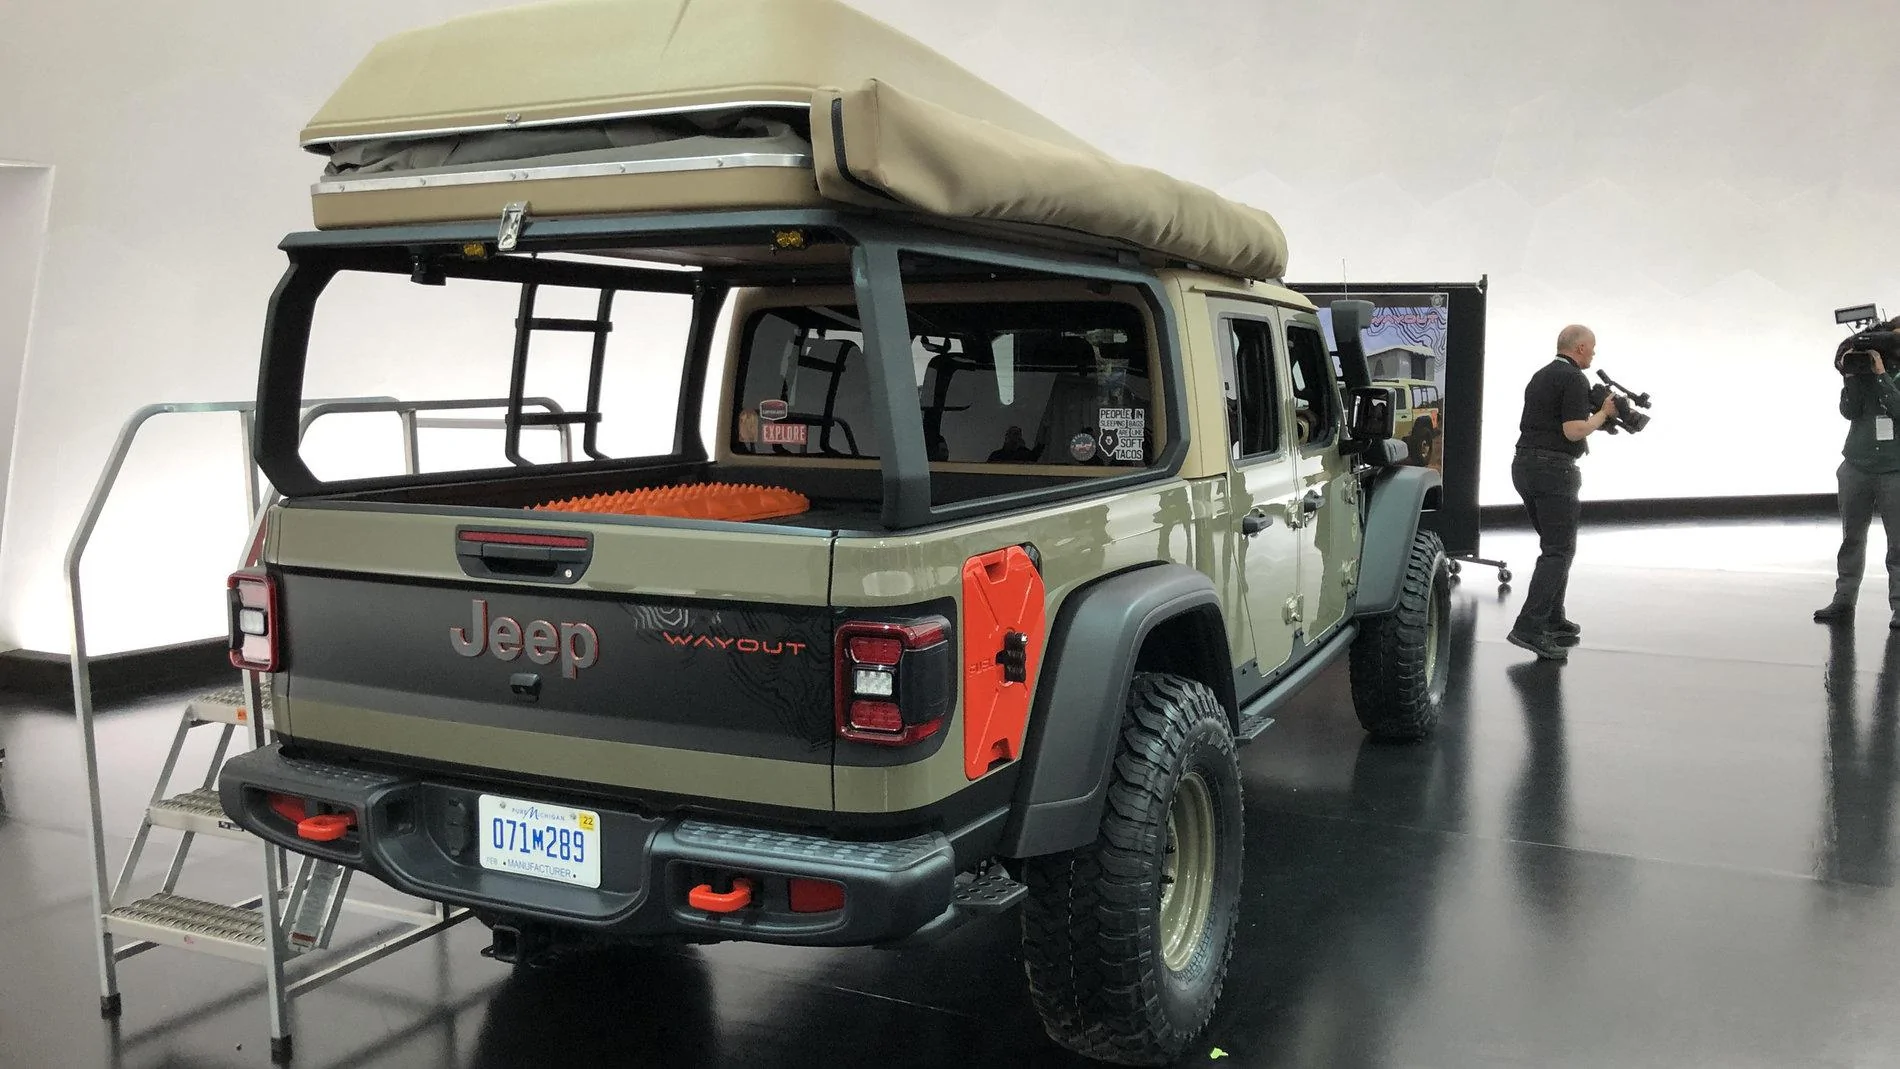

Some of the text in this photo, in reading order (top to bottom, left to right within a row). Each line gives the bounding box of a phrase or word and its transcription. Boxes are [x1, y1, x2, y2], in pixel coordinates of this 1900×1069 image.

[1100, 409, 1144, 420] PEOPLE IN
[763, 425, 806, 441] EXPLORE
[1120, 438, 1143, 448] SOFT
[1115, 449, 1142, 460] TACOS
[450, 599, 600, 680] Jeep
[662, 631, 806, 656] WAYOUT
[583, 816, 593, 826] 22
[492, 817, 585, 863] 071M289
[507, 859, 572, 879] MANUFACTURER
